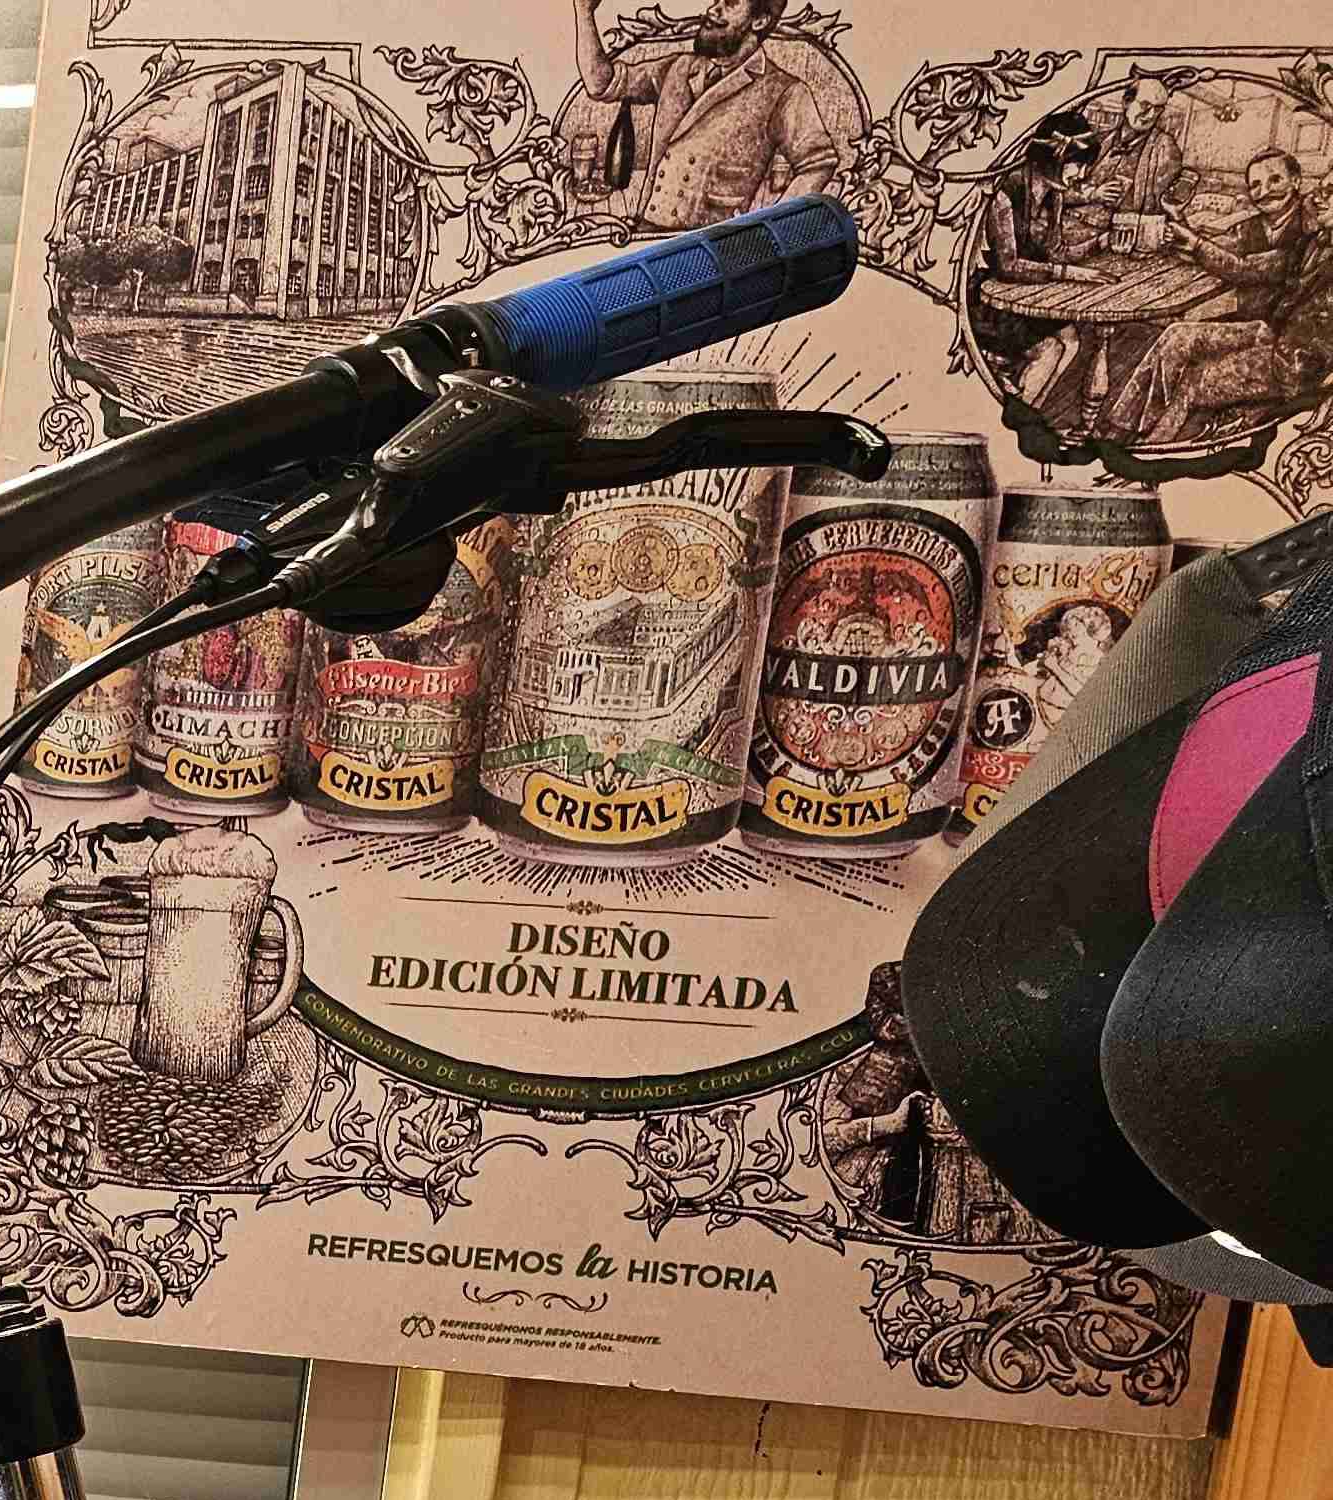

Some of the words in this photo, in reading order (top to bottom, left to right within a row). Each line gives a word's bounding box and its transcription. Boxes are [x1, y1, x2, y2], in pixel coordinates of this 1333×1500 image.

[265, 491, 332, 534] SHIMANO
[327, 665, 421, 693] Pilsener
[421, 672, 469, 695] Bier
[765, 654, 948, 696] VALDIVIA
[42, 750, 126, 777] CRISTAL
[174, 758, 274, 791] CRISTAL
[329, 764, 446, 801] CRISTAL
[535, 787, 679, 833] CRISTAL
[774, 788, 901, 828] CRISTAL
[506, 920, 670, 961] DISEÑO
[367, 955, 560, 1001] EDICIÓN
[568, 968, 799, 1014] LIMITADA
[304, 993, 429, 1071] CONMEMORATIVO
[436, 1064, 456, 1081] DE
[467, 1072, 499, 1090] LAS
[508, 1081, 590, 1100] GRANDES
[600, 1083, 688, 1100] CIUDADES
[307, 1233, 564, 1276] REFRESQUEMOS
[574, 1242, 619, 1280] la
[628, 1258, 779, 1295] HISTORIA
[439, 1330, 486, 1342] Producto
[487, 1334, 512, 1345] para
[513, 1337, 557, 1348] mayores
[558, 1340, 573, 1350] de
[574, 1341, 586, 1351] 18
